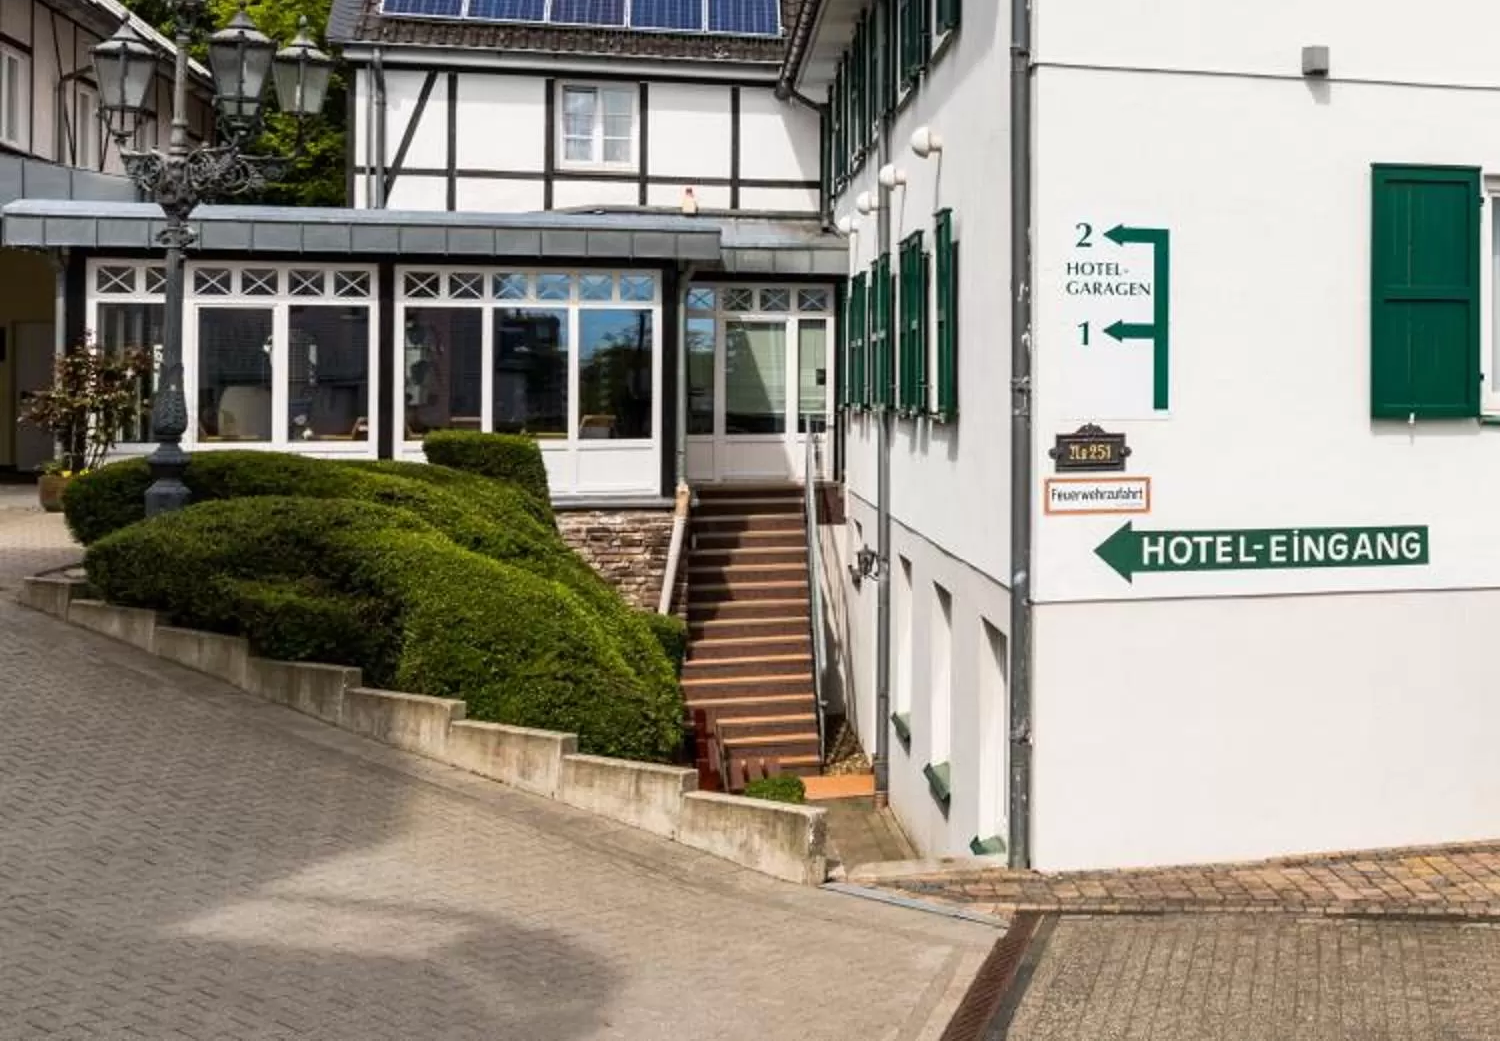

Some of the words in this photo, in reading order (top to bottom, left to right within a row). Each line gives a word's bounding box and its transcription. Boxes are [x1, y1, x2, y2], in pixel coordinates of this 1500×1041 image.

[1075, 222, 1093, 248] 2
[1066, 262, 1130, 276] HOTEL-
[1065, 280, 1151, 296] GARAGEN
[1077, 320, 1090, 346] 1
[1051, 486, 1143, 502] Feuerwehrzufahrt
